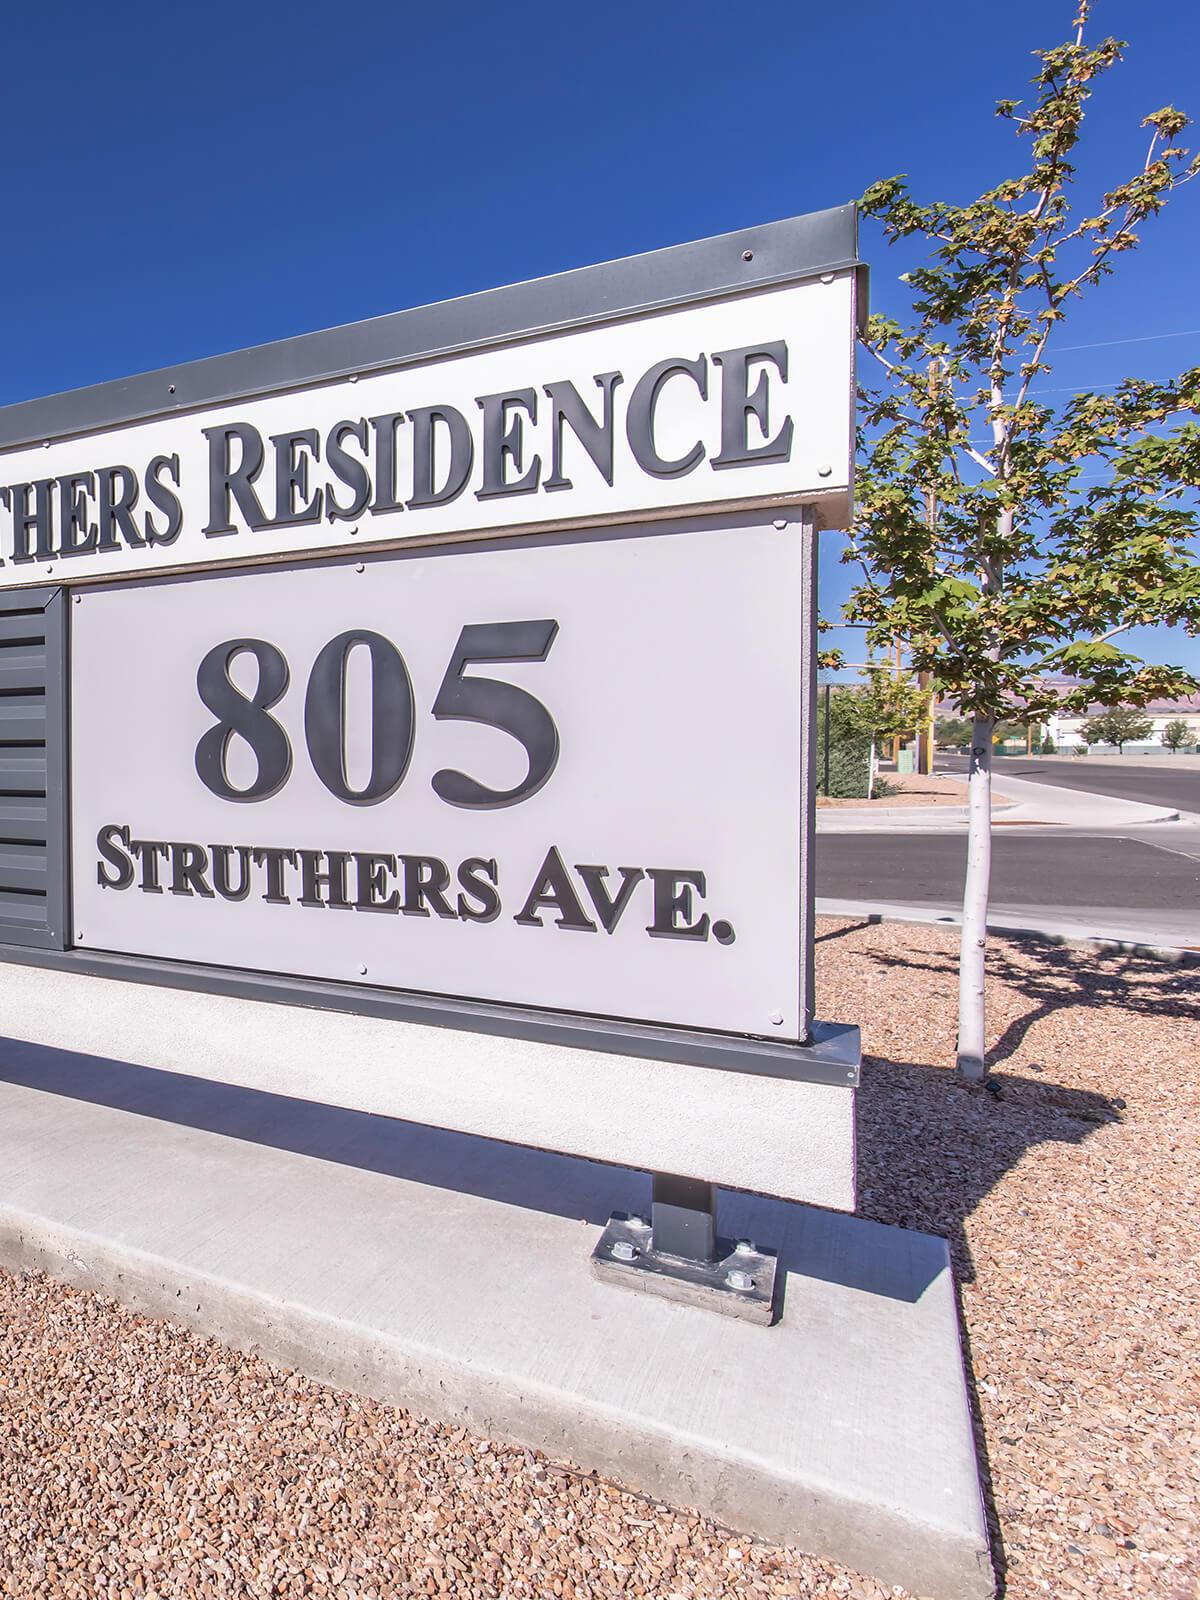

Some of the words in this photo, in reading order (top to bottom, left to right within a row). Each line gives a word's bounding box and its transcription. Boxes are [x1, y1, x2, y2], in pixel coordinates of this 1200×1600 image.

[201, 340, 794, 539] RESIDENCE
[194, 619, 561, 811] 805
[97, 825, 502, 924] STRUTHERS
[513, 845, 737, 946] AVE.
